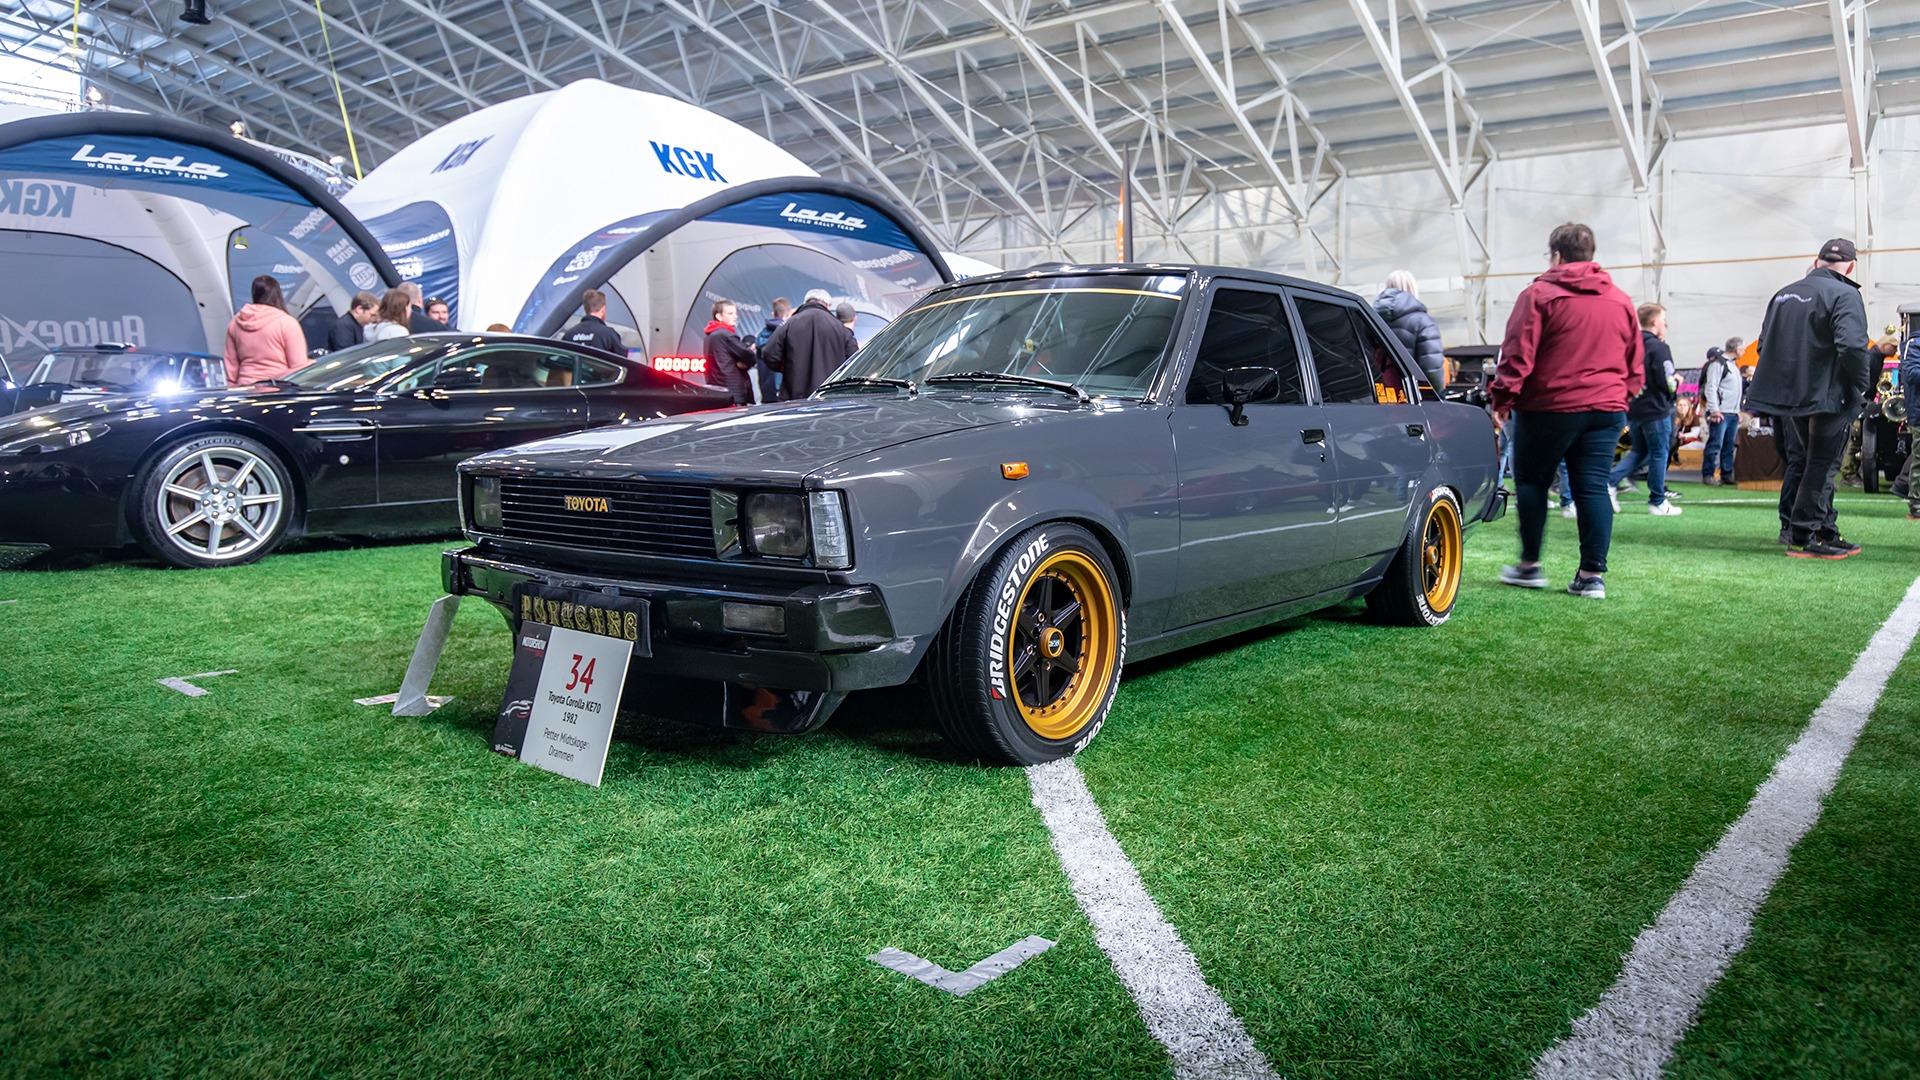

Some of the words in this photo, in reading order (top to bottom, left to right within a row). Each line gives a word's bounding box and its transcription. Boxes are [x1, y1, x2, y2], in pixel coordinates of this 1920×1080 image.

[71, 144, 229, 178] Lada
[429, 134, 496, 175] KGK
[648, 140, 729, 184] KGK
[86, 162, 129, 172] WORLD
[135, 166, 173, 176] RALLY
[177, 172, 209, 181] TEAM
[780, 202, 867, 230] Lada
[787, 217, 812, 225] WORLD
[813, 220, 834, 228] RALLY
[565, 496, 609, 512] TOYOTA
[989, 533, 1049, 699] BRIDGESTONE
[565, 654, 596, 695] 34
[548, 691, 566, 705] Toyota
[565, 695, 586, 710] Corolla
[585, 700, 602, 714] KE70
[562, 711, 578, 725] 1982
[543, 727, 560, 741] Petter
[548, 744, 575, 762] Drammen
